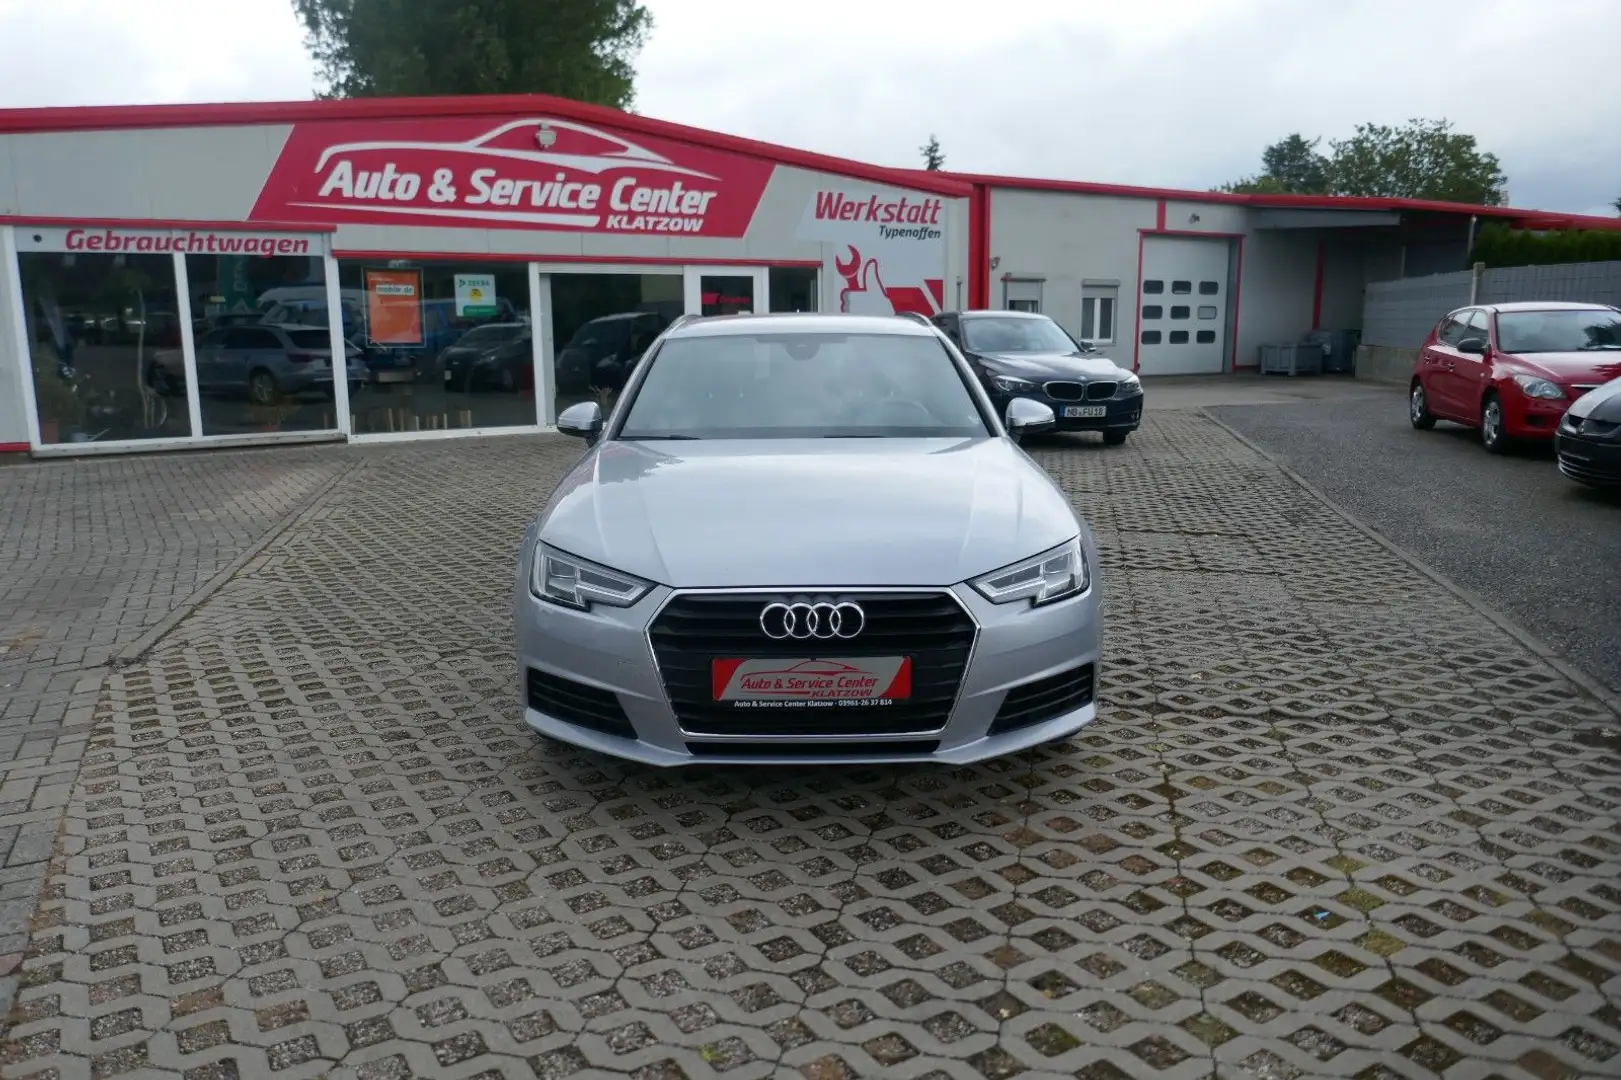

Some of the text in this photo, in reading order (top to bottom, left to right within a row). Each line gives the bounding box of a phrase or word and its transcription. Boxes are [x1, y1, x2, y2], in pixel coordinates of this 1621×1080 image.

[318, 160, 718, 216] Auto & Service Center
[815, 191, 942, 225] Werkstatt
[606, 215, 704, 232] KLATZOW
[879, 224, 941, 240] Typenoffen
[65, 229, 309, 258] Gebrauchtwagen
[741, 676, 880, 690] Auto & Service Center
[811, 689, 873, 698] KLATZOW
[807, 700, 834, 708] Klatzow
